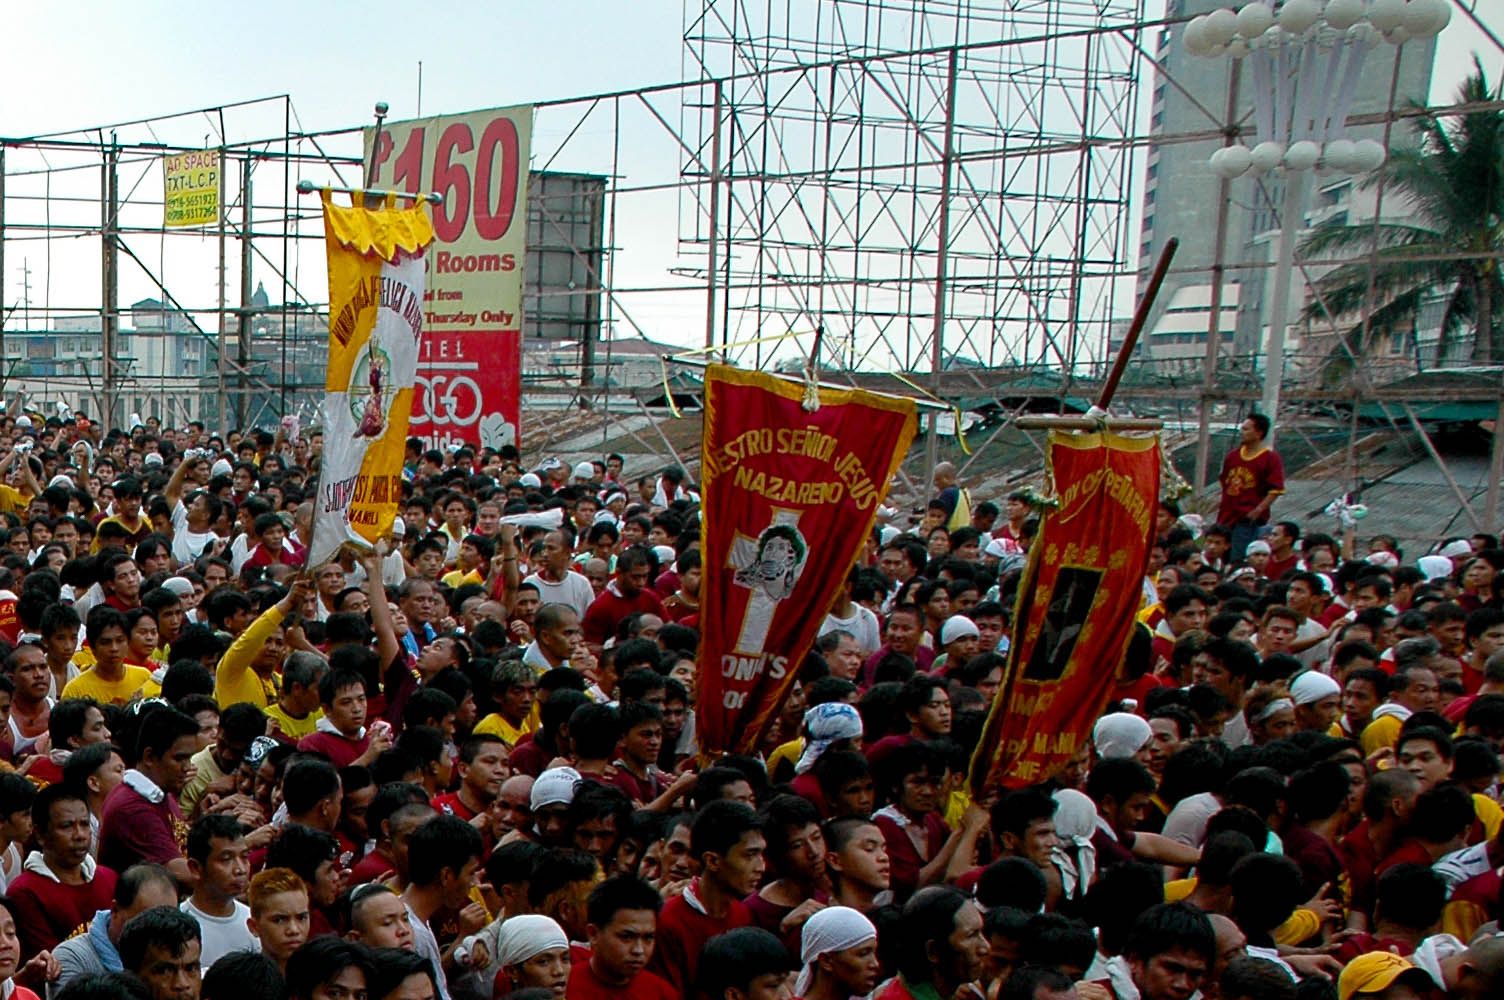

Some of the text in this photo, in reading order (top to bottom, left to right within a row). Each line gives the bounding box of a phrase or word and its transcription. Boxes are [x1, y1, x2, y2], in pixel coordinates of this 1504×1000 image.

[168, 152, 216, 172] AD SPACE
[437, 251, 516, 273] Rooms
[480, 310, 514, 326] Only
[424, 340, 464, 358] TEL
[734, 466, 843, 504] NAZARENO
[834, 452, 879, 510] JESUS
